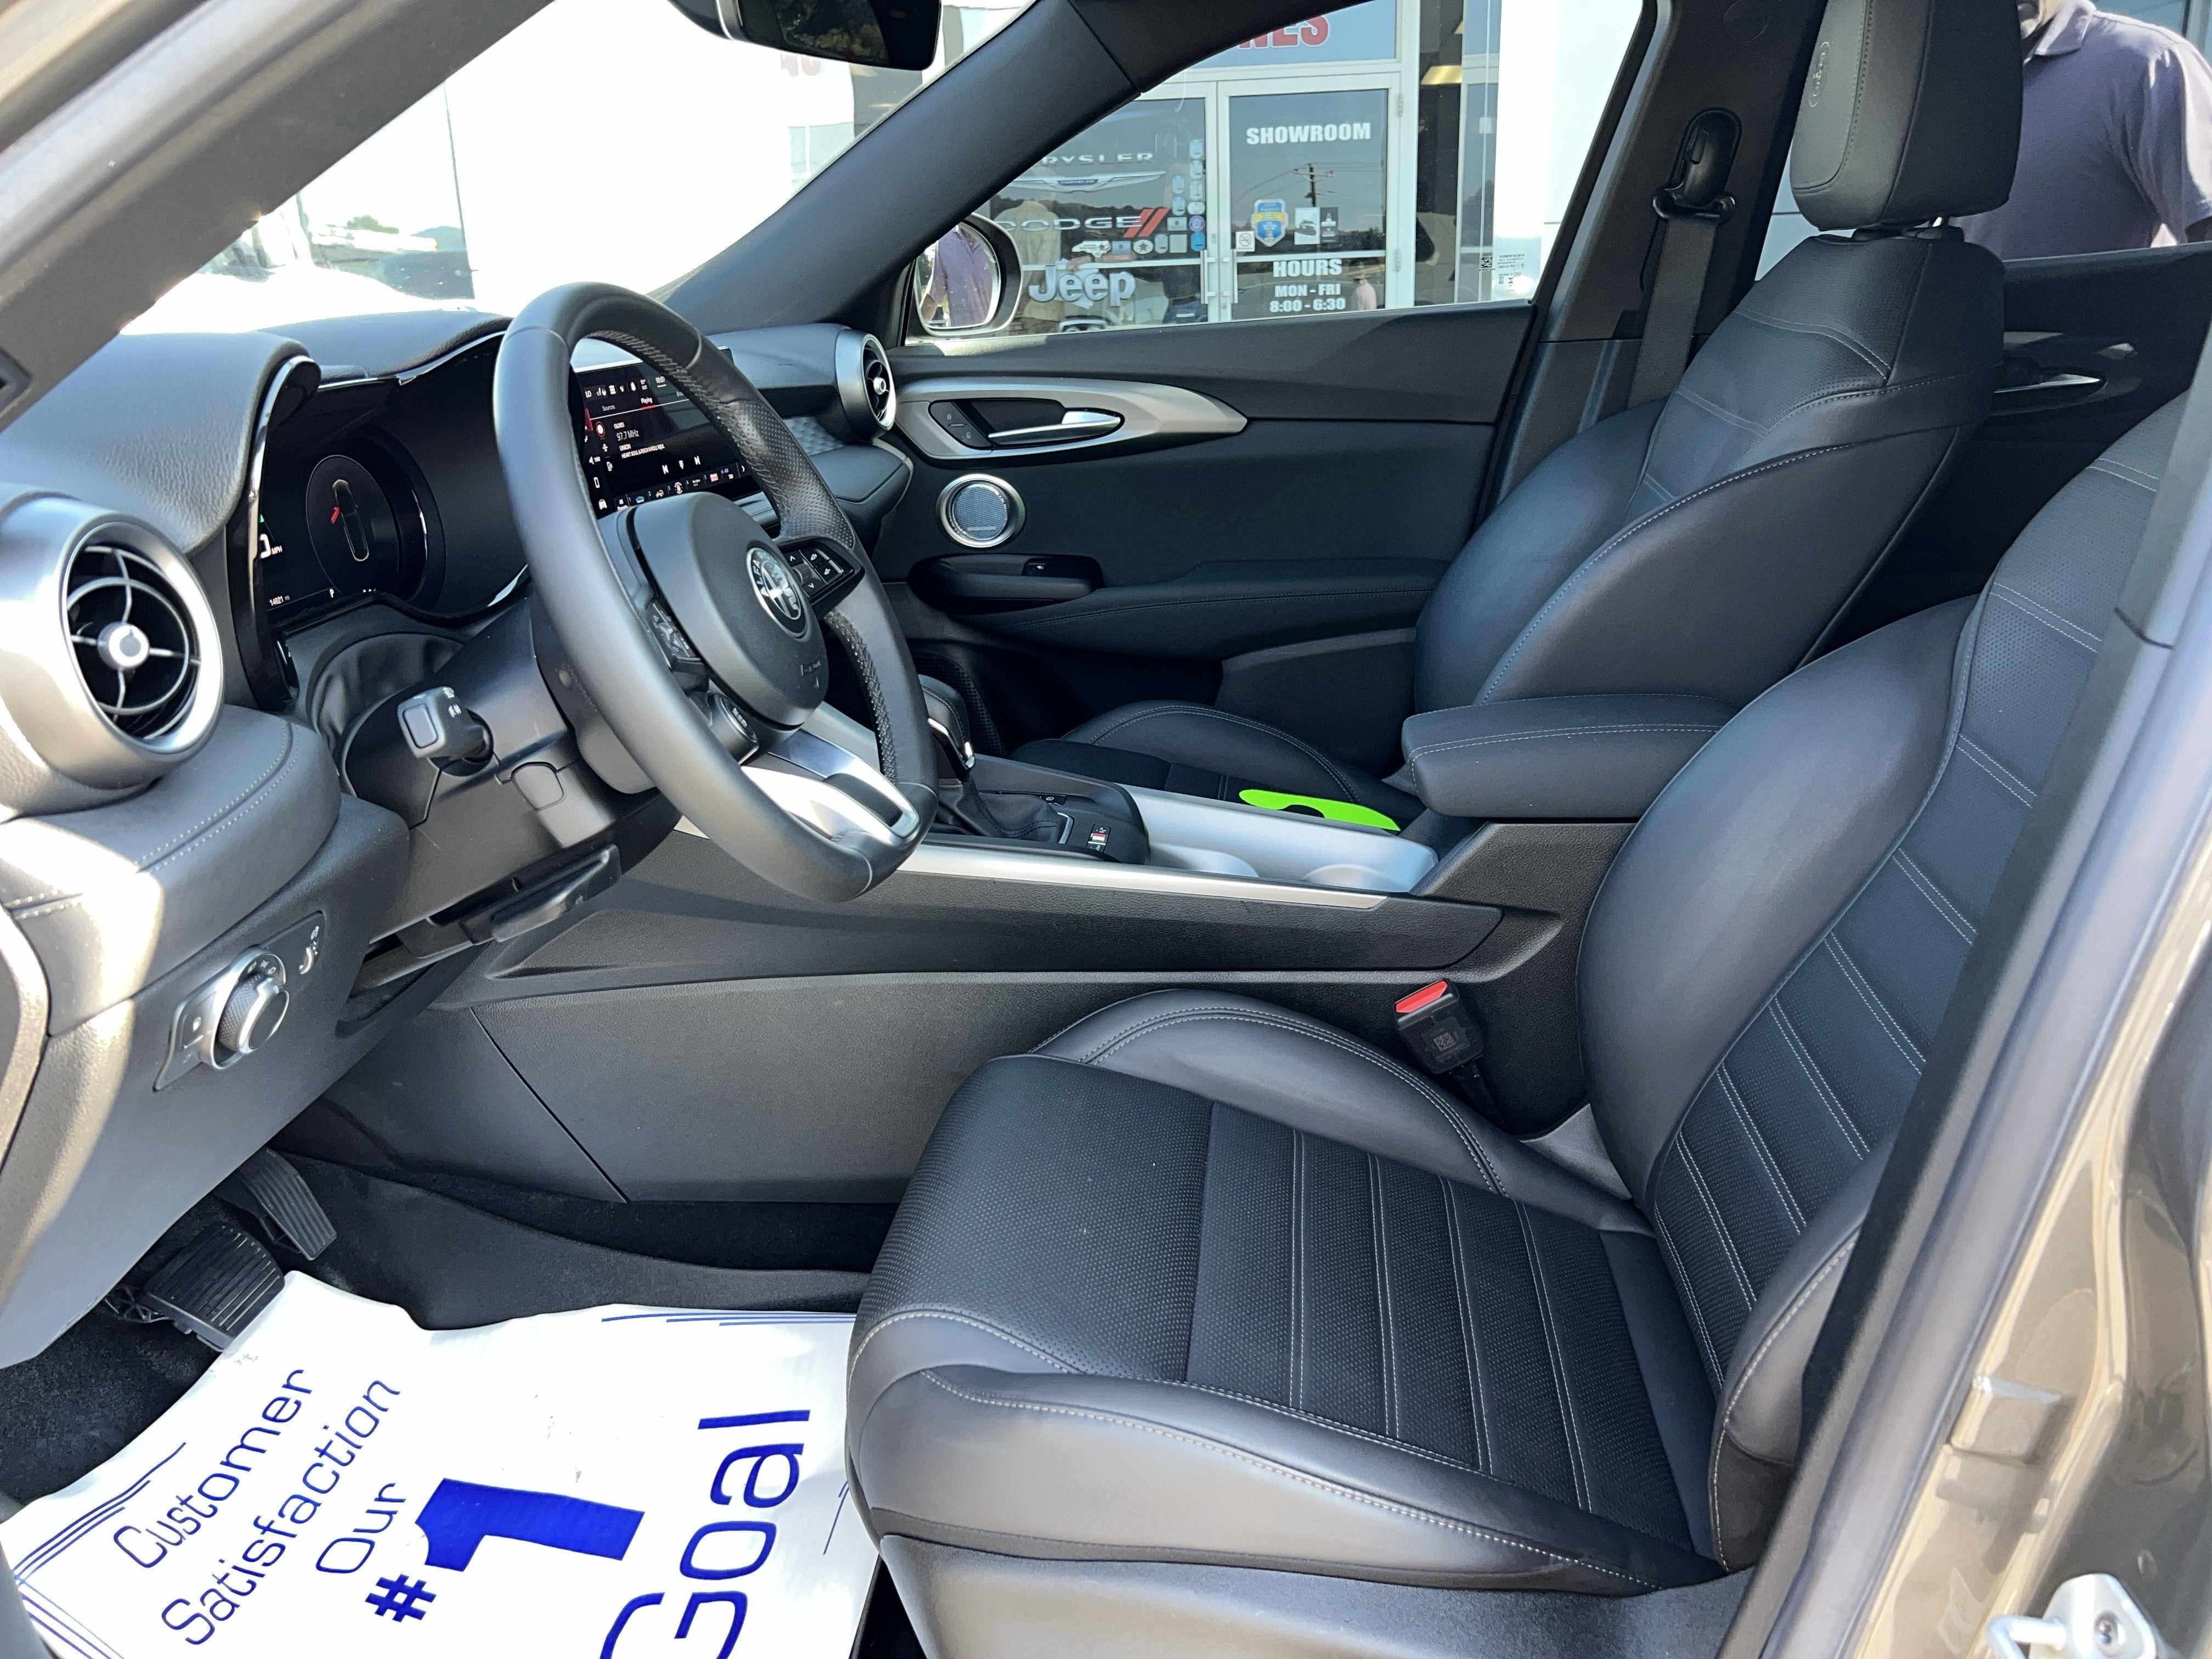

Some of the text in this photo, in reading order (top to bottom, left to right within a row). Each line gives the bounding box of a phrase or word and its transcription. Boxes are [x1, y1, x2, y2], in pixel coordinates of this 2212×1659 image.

[1245, 122, 1371, 145] SHOWROOM
[1273, 259, 1343, 277] HOURS
[1028, 265, 1137, 307] Jeep
[1274, 284, 1308, 297] MON
[1318, 284, 1341, 295] FRI
[1269, 300, 1302, 312] 8:00
[1313, 298, 1346, 311] 6:30
[616, 429, 639, 441] 97.7 MHz
[329, 589, 334, 598] P
[113, 1368, 315, 1570] Customer
[161, 1379, 401, 1645] Satisfaction
[315, 1482, 406, 1575] Our
[599, 1409, 811, 1659] Goal
